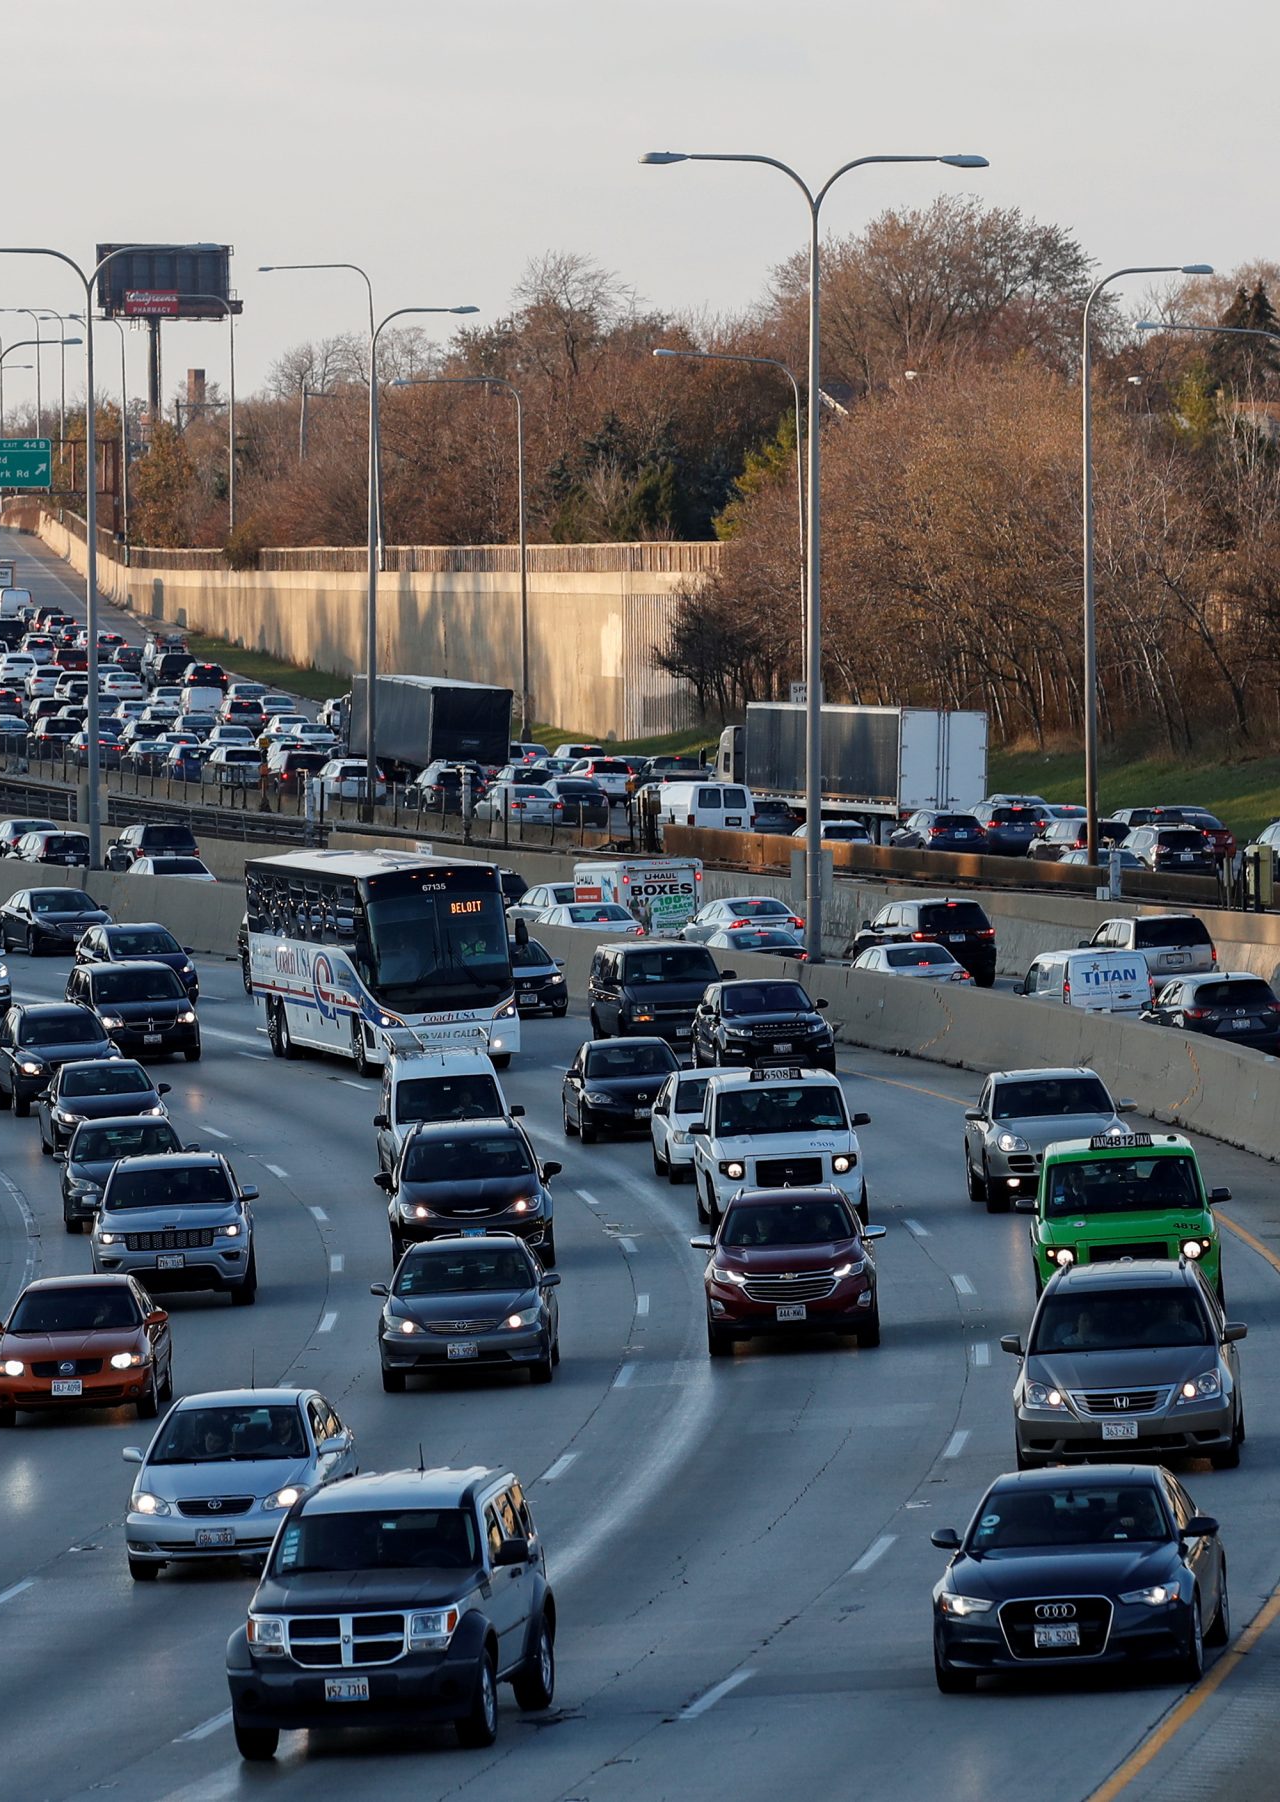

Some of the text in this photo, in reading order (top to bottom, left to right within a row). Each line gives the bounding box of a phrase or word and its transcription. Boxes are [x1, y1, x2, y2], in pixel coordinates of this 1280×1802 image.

[125, 291, 178, 305] Walgreens
[23, 441, 46, 449] 44B
[17, 469, 30, 478] Rd
[422, 882, 447, 892] 67135
[630, 883, 693, 896] BOXES
[450, 901, 482, 914] BELOIT
[275, 946, 296, 975] Coach
[296, 947, 312, 979] USA
[423, 1011, 476, 1022] Coach USA
[431, 1028, 490, 1040] VAN GALDR
[764, 1069, 789, 1079] 6508
[1093, 1133, 1151, 1148] TAXI 4812 TAXI
[1173, 1222, 1200, 1232] 4812
[1056, 1630, 1078, 1642] 5203
